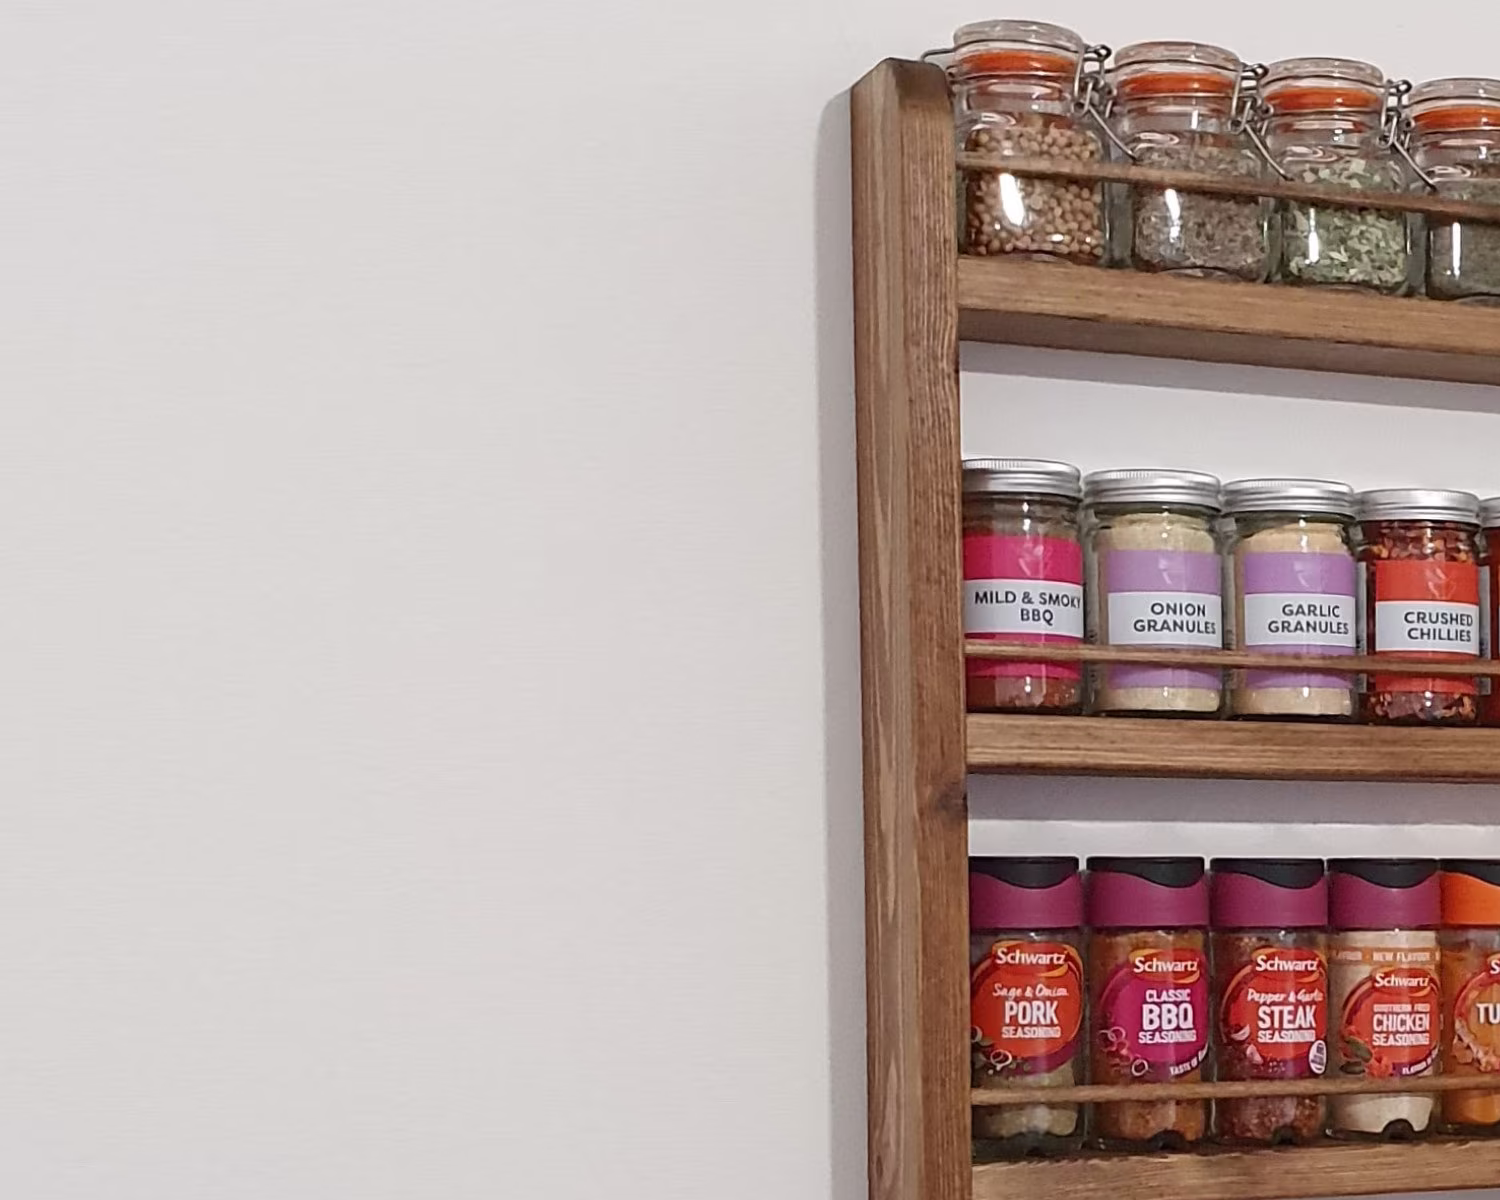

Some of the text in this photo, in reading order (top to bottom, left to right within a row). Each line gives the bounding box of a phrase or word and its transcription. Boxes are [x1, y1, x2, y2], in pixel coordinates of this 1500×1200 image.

[974, 591, 1081, 609] MILD & SMOKY
[1020, 608, 1054, 625] BBQ
[1150, 602, 1206, 617] ONION
[1282, 604, 1341, 618] GARLIC
[1133, 619, 1217, 635] GRANULES
[1404, 611, 1474, 627] CRUSHED
[1267, 620, 1349, 635] GRANULES
[1407, 627, 1472, 643] CHILLIES
[995, 948, 1068, 965] Schwartz
[1255, 955, 1319, 972] Schwartz
[1133, 956, 1198, 974] Schwartz
[1374, 973, 1430, 987] Schwartz
[992, 983, 1022, 1001] Sage
[1035, 983, 1069, 997] Onion
[1145, 989, 1191, 1002] CLASSIC
[1247, 988, 1287, 1004] Pepper
[1004, 1000, 1059, 1025] PORK
[1142, 1003, 1194, 1031] BBQ
[1257, 1004, 1317, 1029] STEAK
[1373, 1013, 1430, 1032] CHICKEN
[1001, 1026, 1061, 1038] SEASONING
[1138, 1030, 1197, 1044] SEASONING
[1257, 1029, 1316, 1043] SEASONING
[1372, 1032, 1430, 1046] SEASONING
